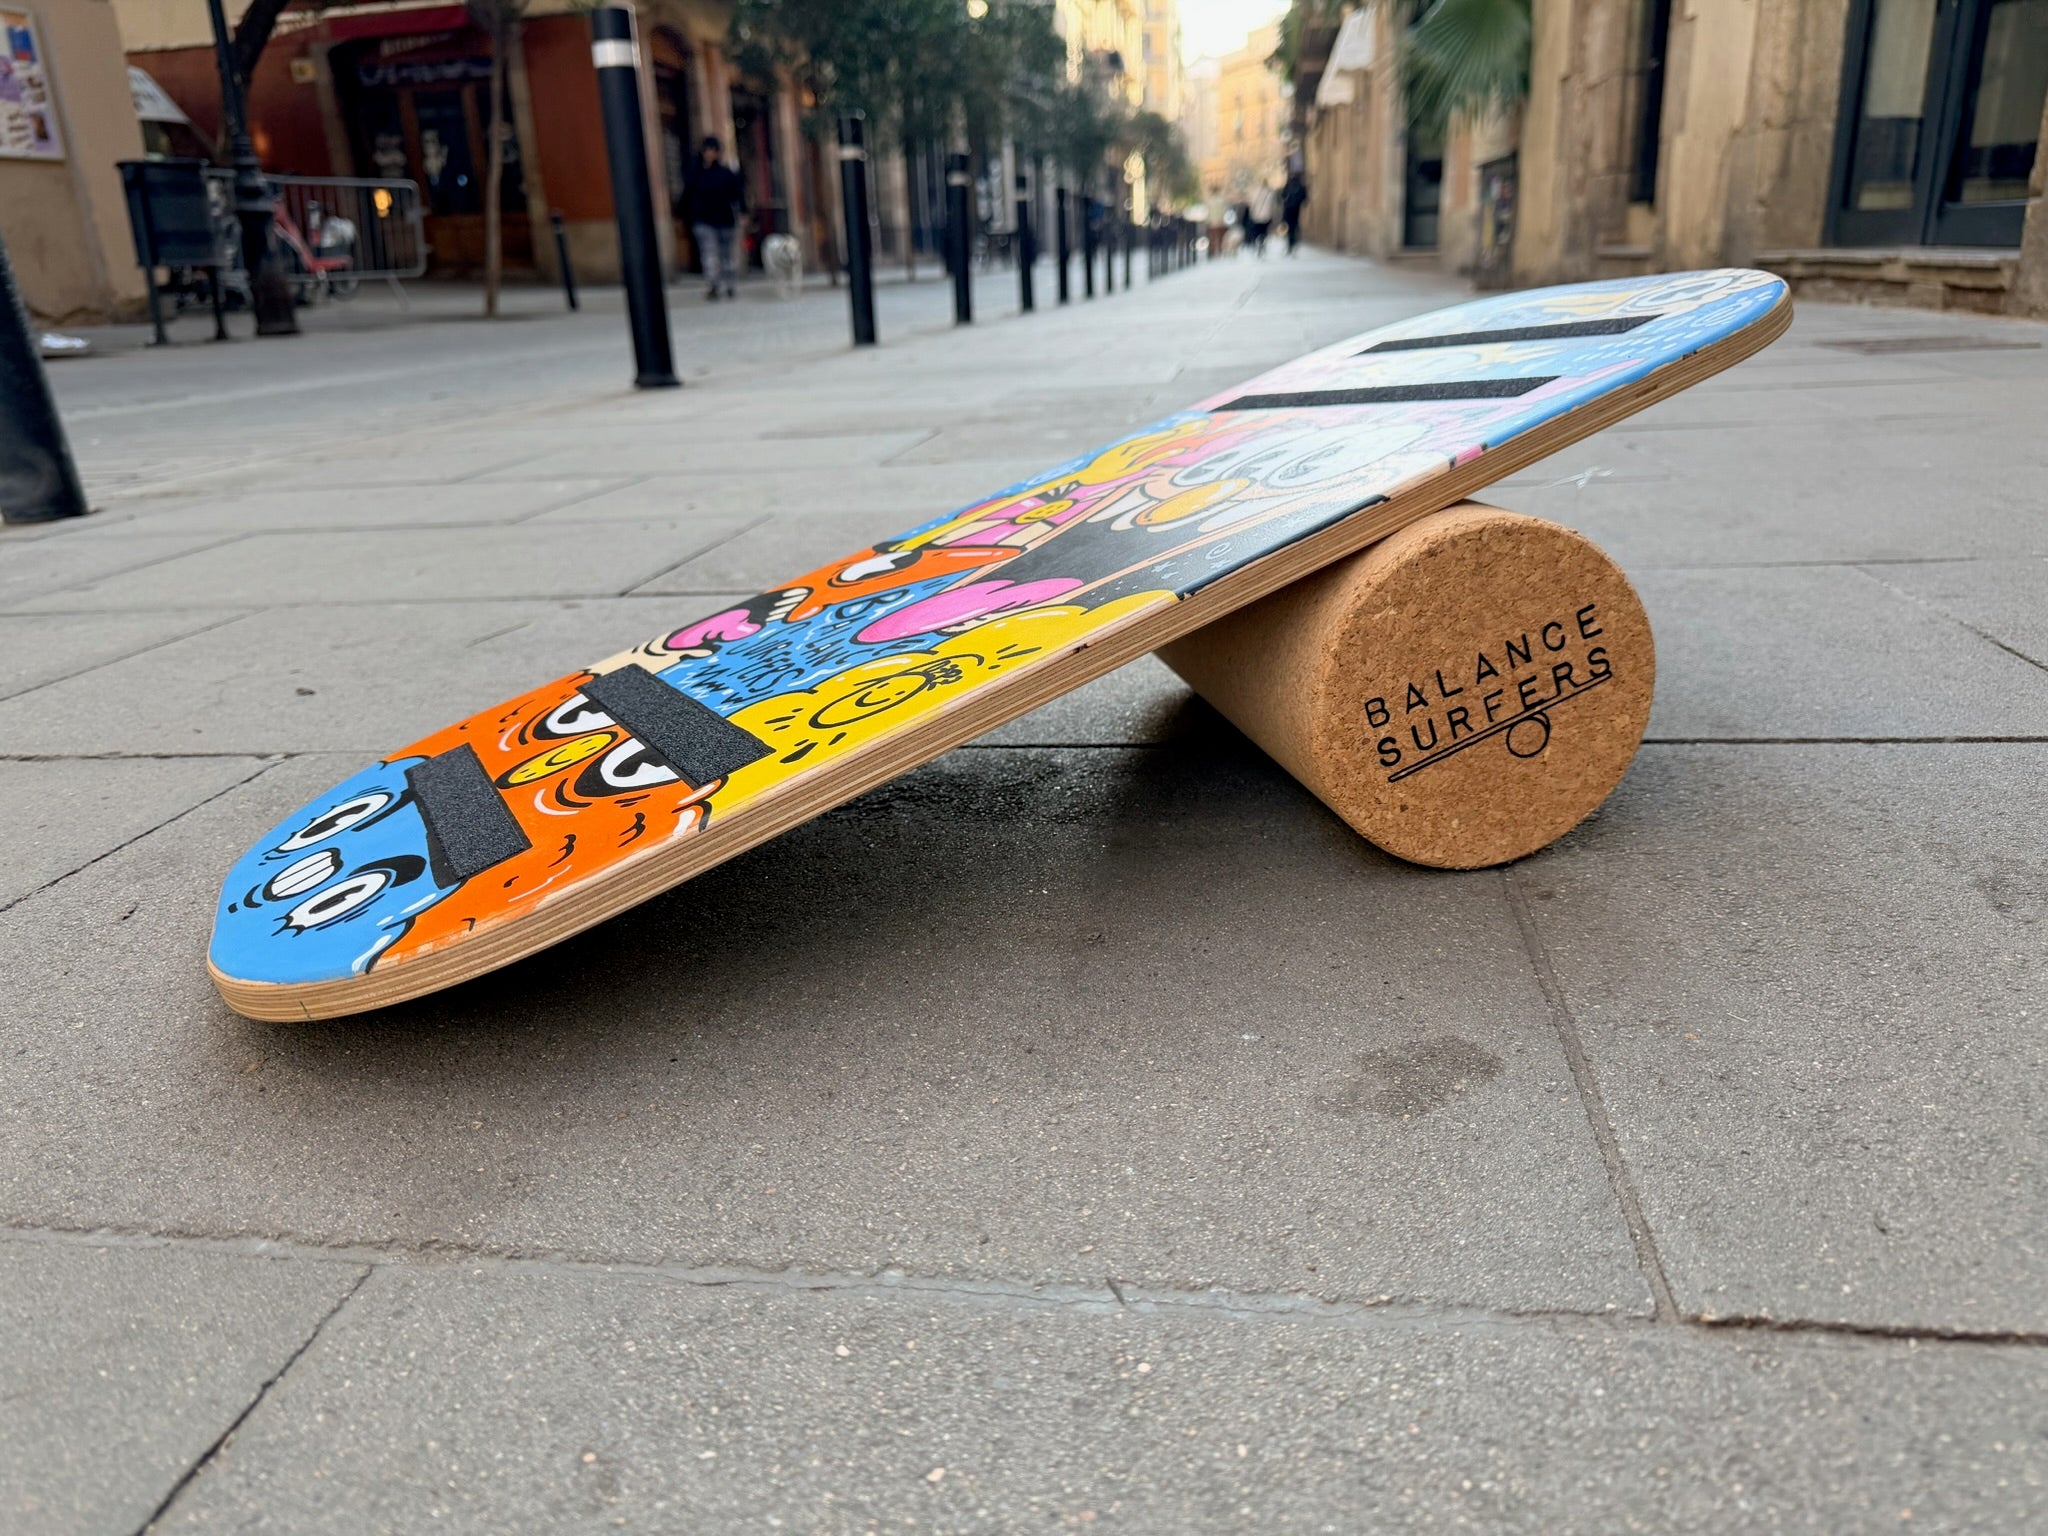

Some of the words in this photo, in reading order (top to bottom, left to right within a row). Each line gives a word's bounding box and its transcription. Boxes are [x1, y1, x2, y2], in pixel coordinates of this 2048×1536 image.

[726, 620, 811, 692] SURFERS
[802, 589, 925, 667] BALANCE
[1365, 604, 1603, 728] BALANCE
[1377, 647, 1611, 767] SURFERS
